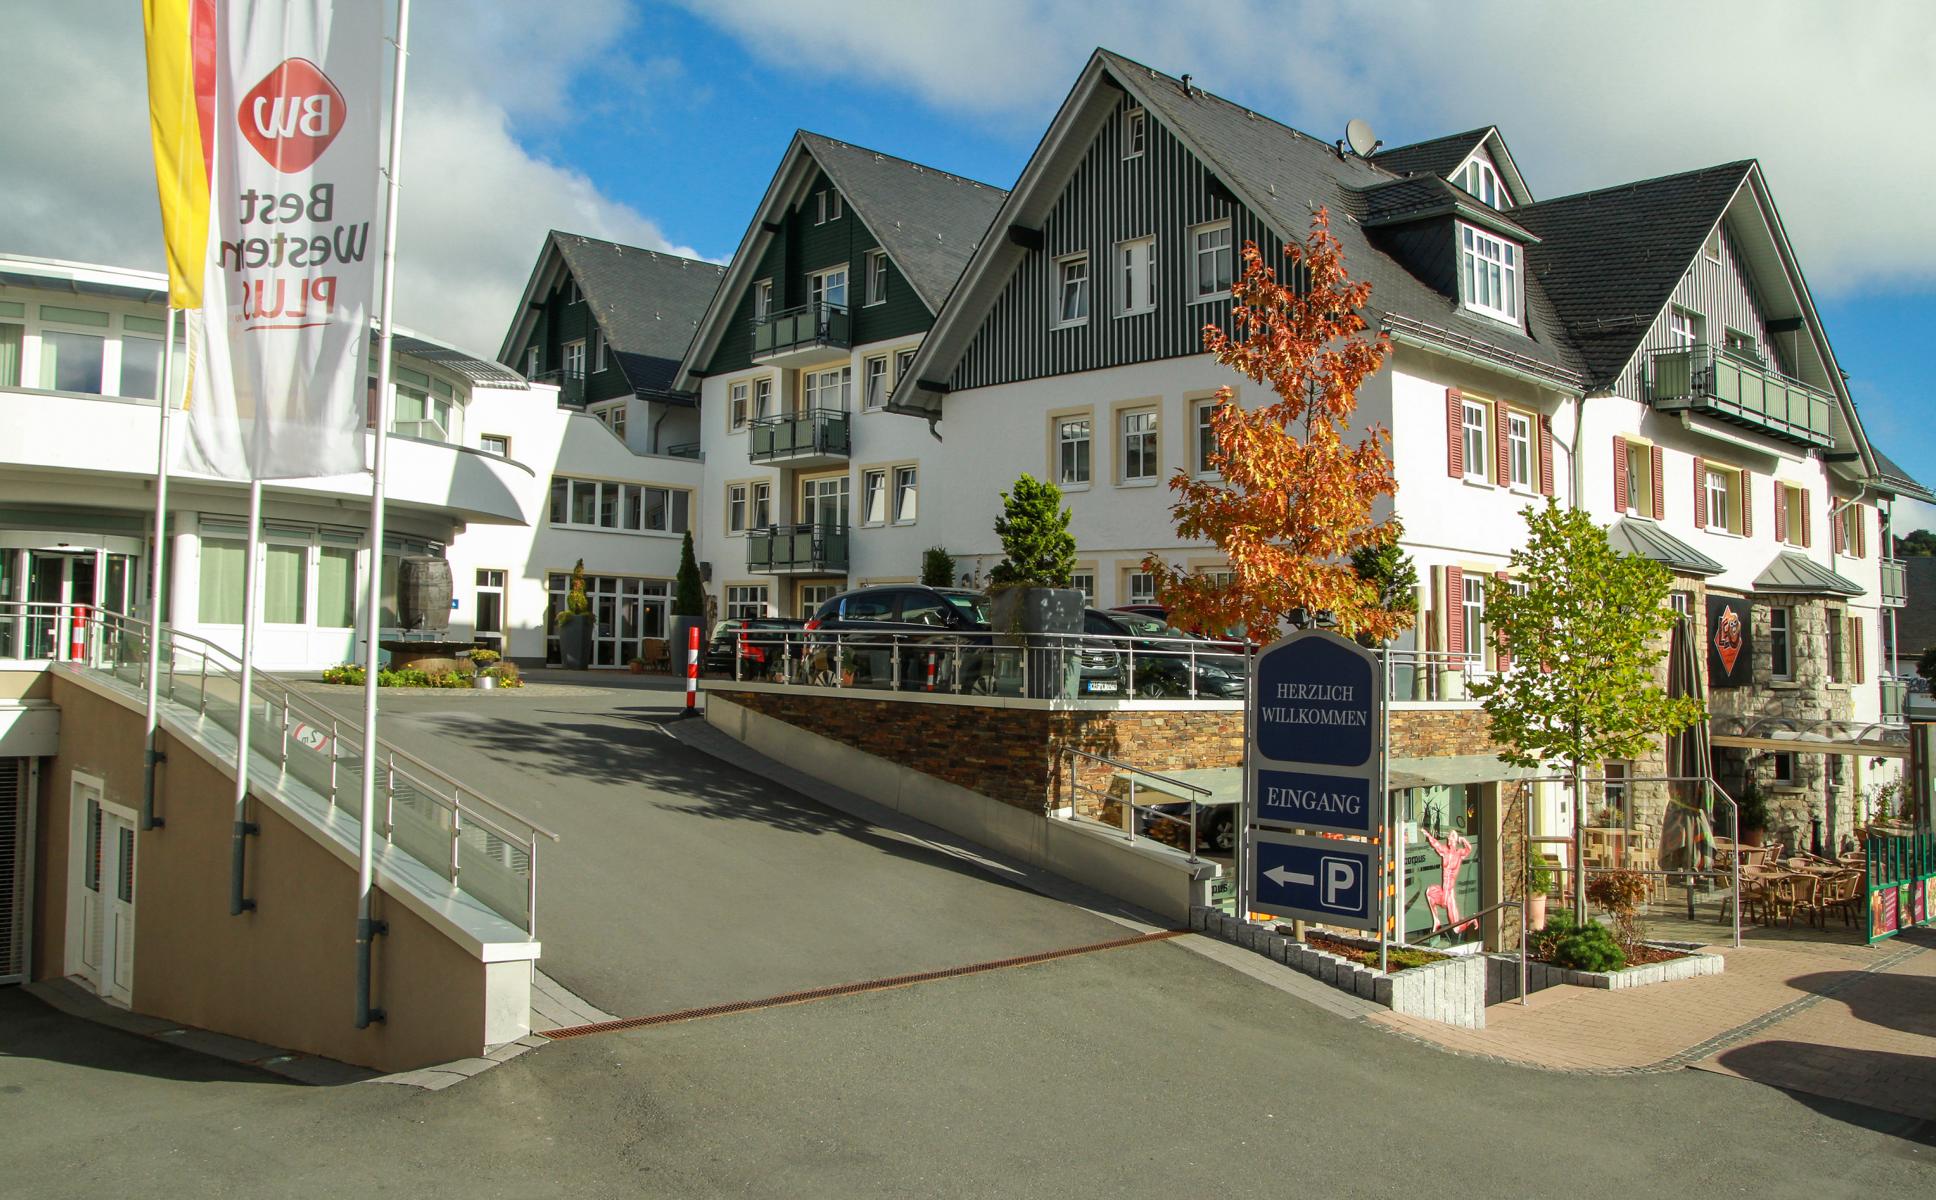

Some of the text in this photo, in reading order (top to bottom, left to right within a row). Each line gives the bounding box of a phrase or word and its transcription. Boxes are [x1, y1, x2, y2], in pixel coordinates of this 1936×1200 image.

[1276, 683, 1354, 702] HERZLICH
[1261, 706, 1368, 726] WILLKOMMEN
[1266, 787, 1361, 815] EINGANG
[1327, 861, 1355, 903] P
